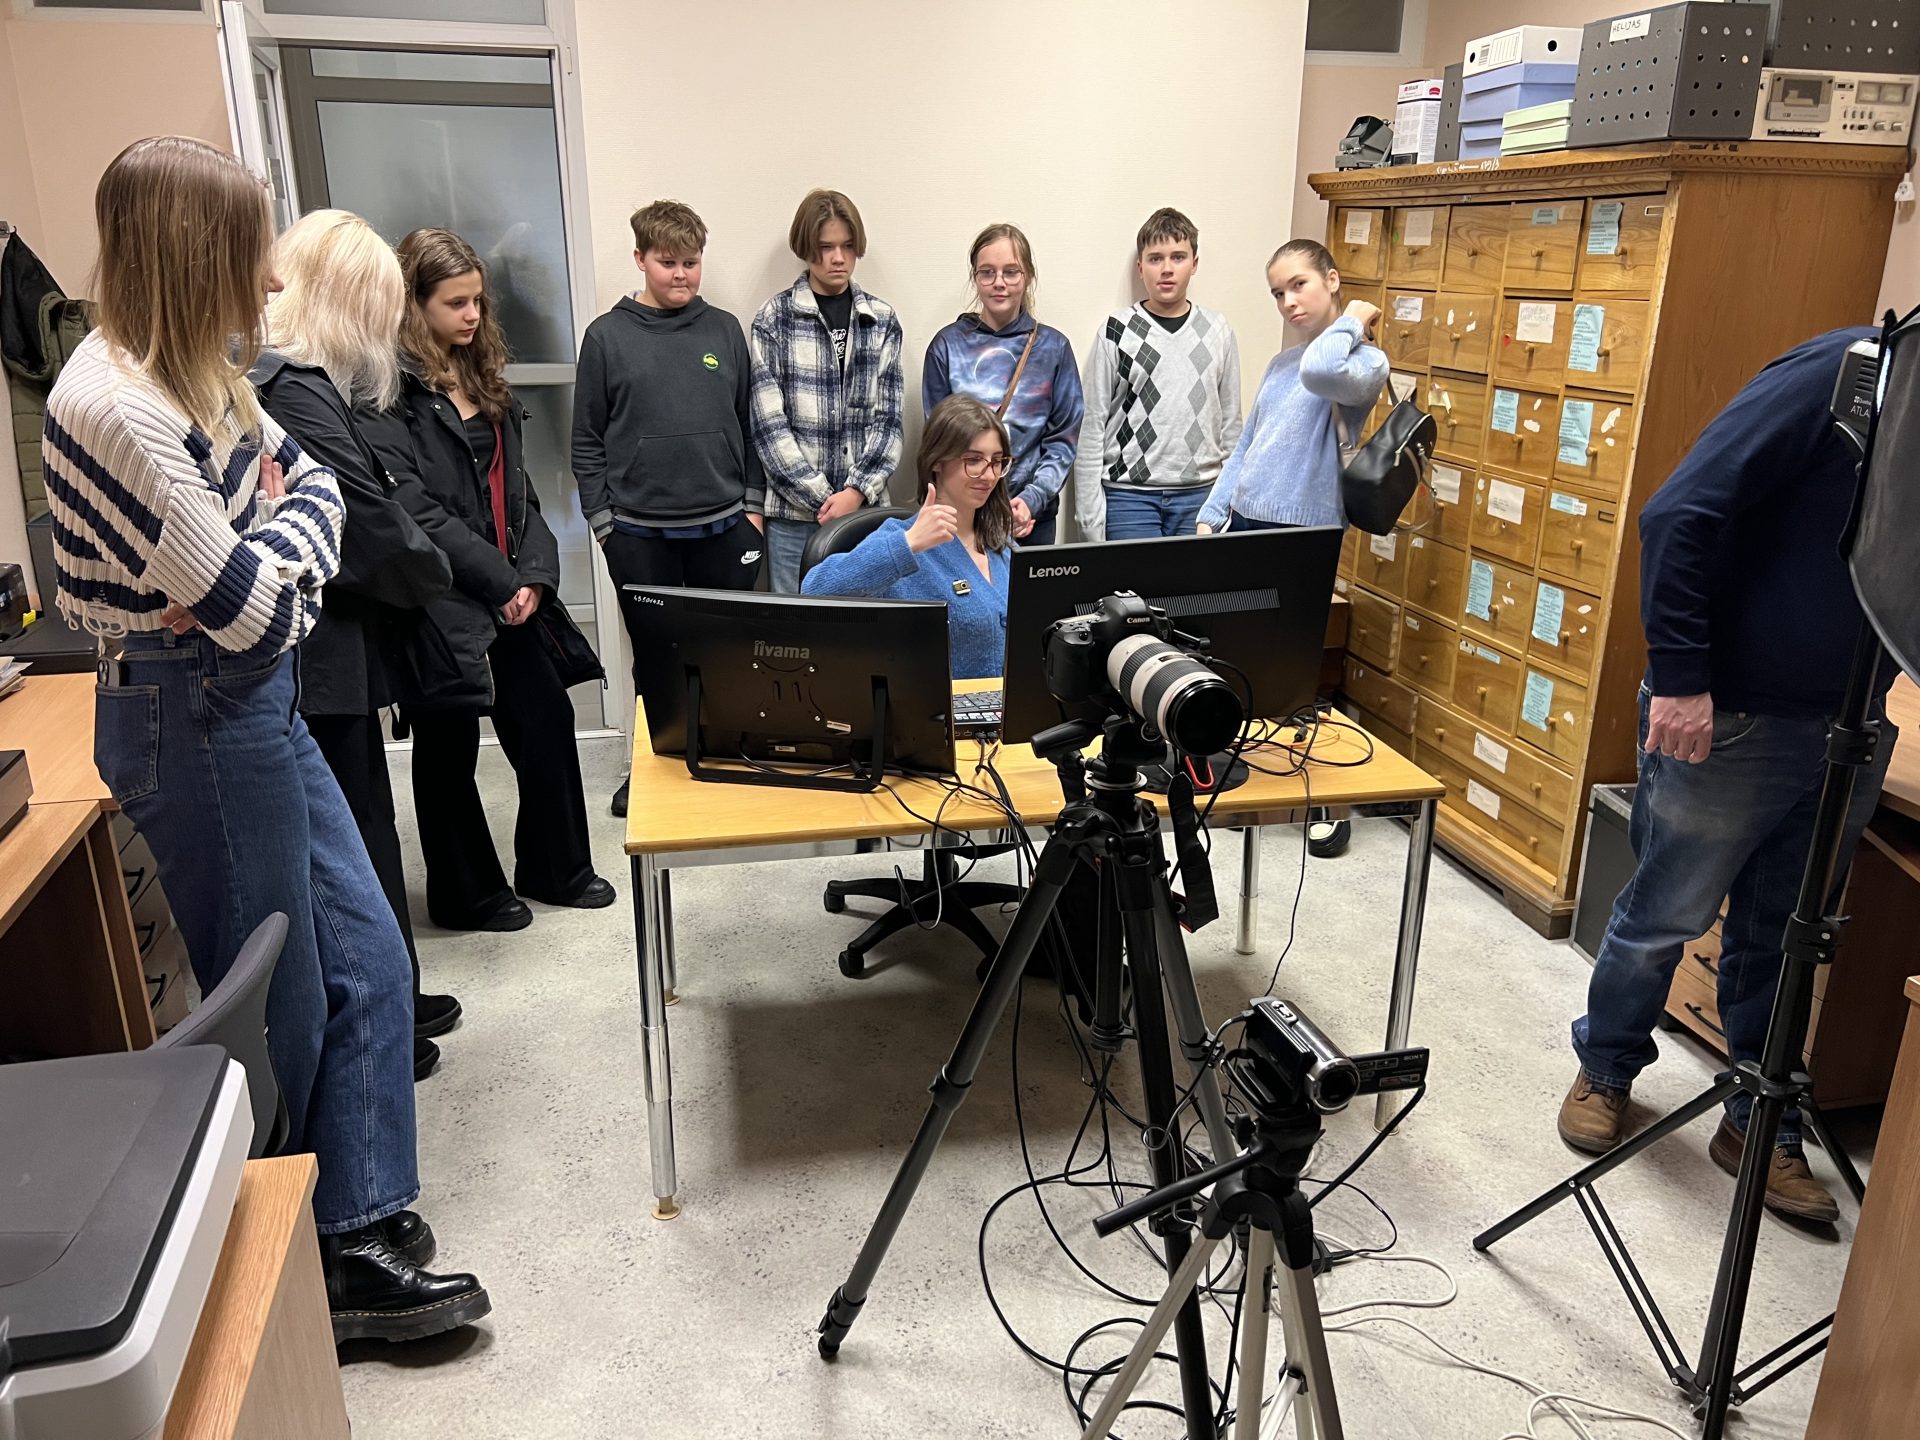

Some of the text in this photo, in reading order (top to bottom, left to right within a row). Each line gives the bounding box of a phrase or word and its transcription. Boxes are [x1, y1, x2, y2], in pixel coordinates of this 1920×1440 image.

[744, 550, 761, 559] NIKE
[1029, 565, 1080, 578] Lenovo
[1126, 616, 1151, 624] Canon
[754, 640, 810, 659] iiyama
[1403, 1053, 1424, 1061] SONY
